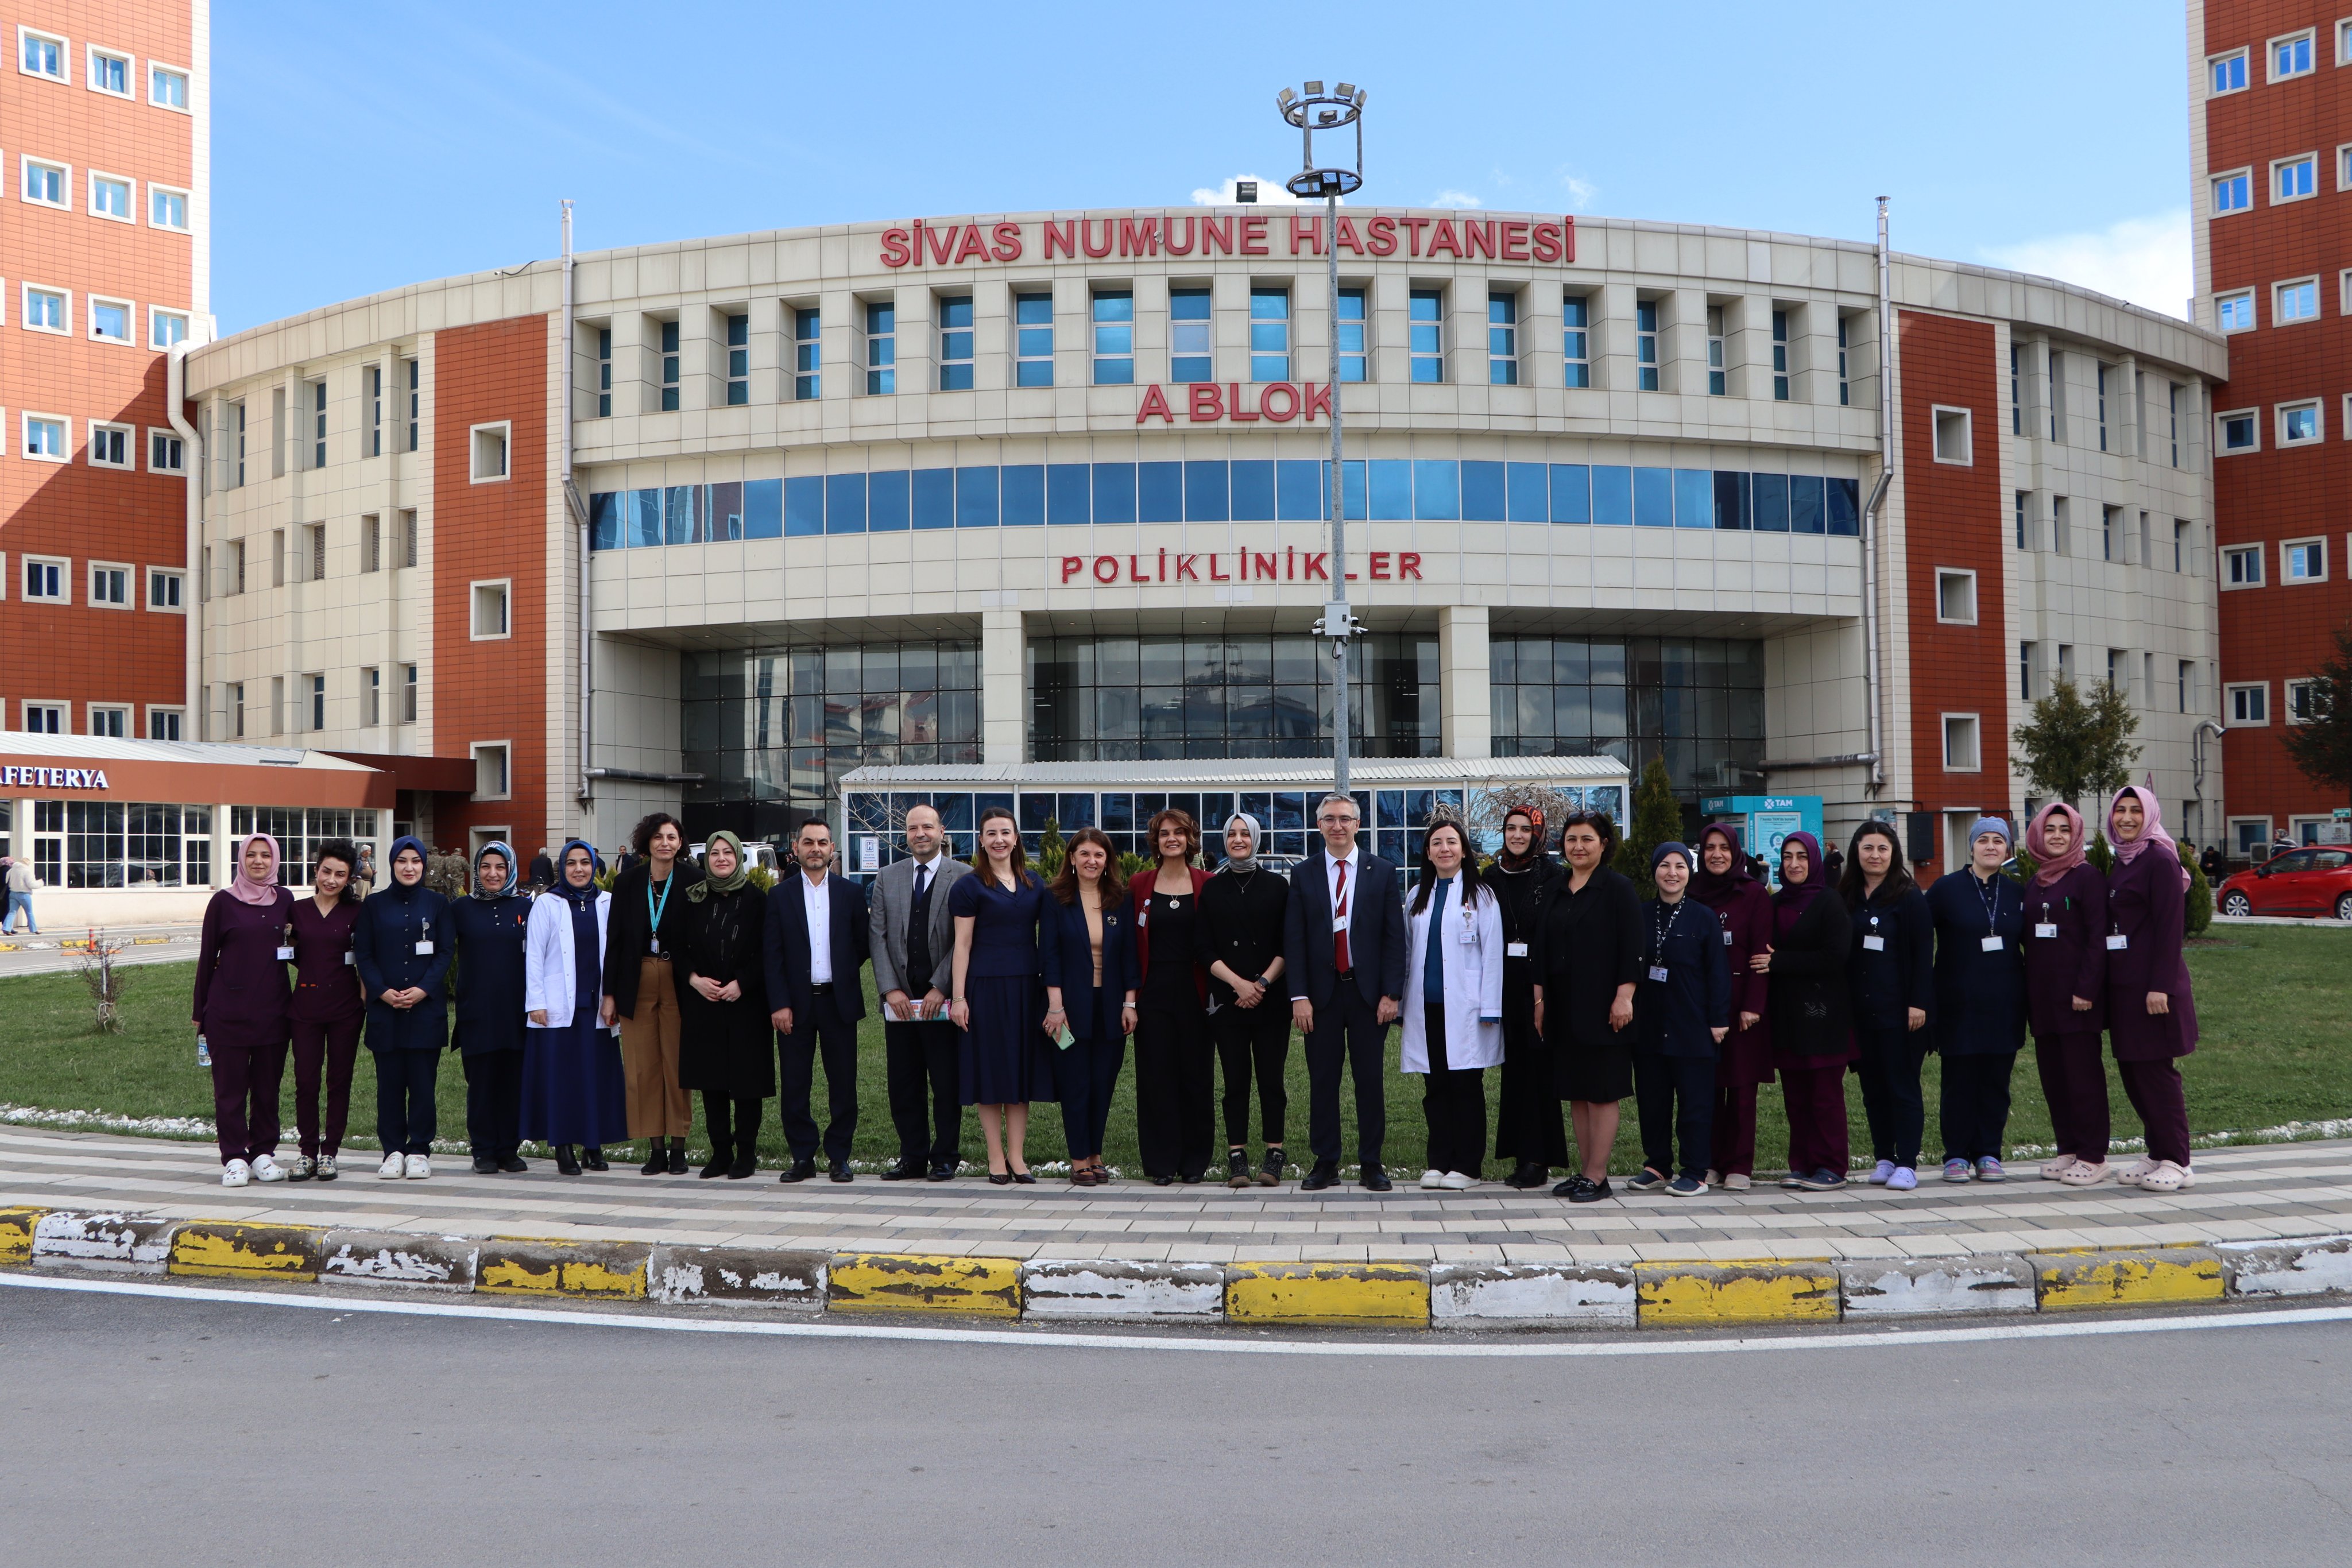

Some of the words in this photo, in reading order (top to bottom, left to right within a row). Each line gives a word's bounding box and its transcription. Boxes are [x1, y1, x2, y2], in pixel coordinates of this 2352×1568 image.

[880, 219, 1022, 268] SİVAS
[1043, 215, 1269, 259] NUMUNE
[1290, 215, 1576, 262] HASTANESİ
[1136, 384, 1174, 423] A
[1189, 382, 1331, 422] BLOK
[1714, 800, 1724, 808] TAM
